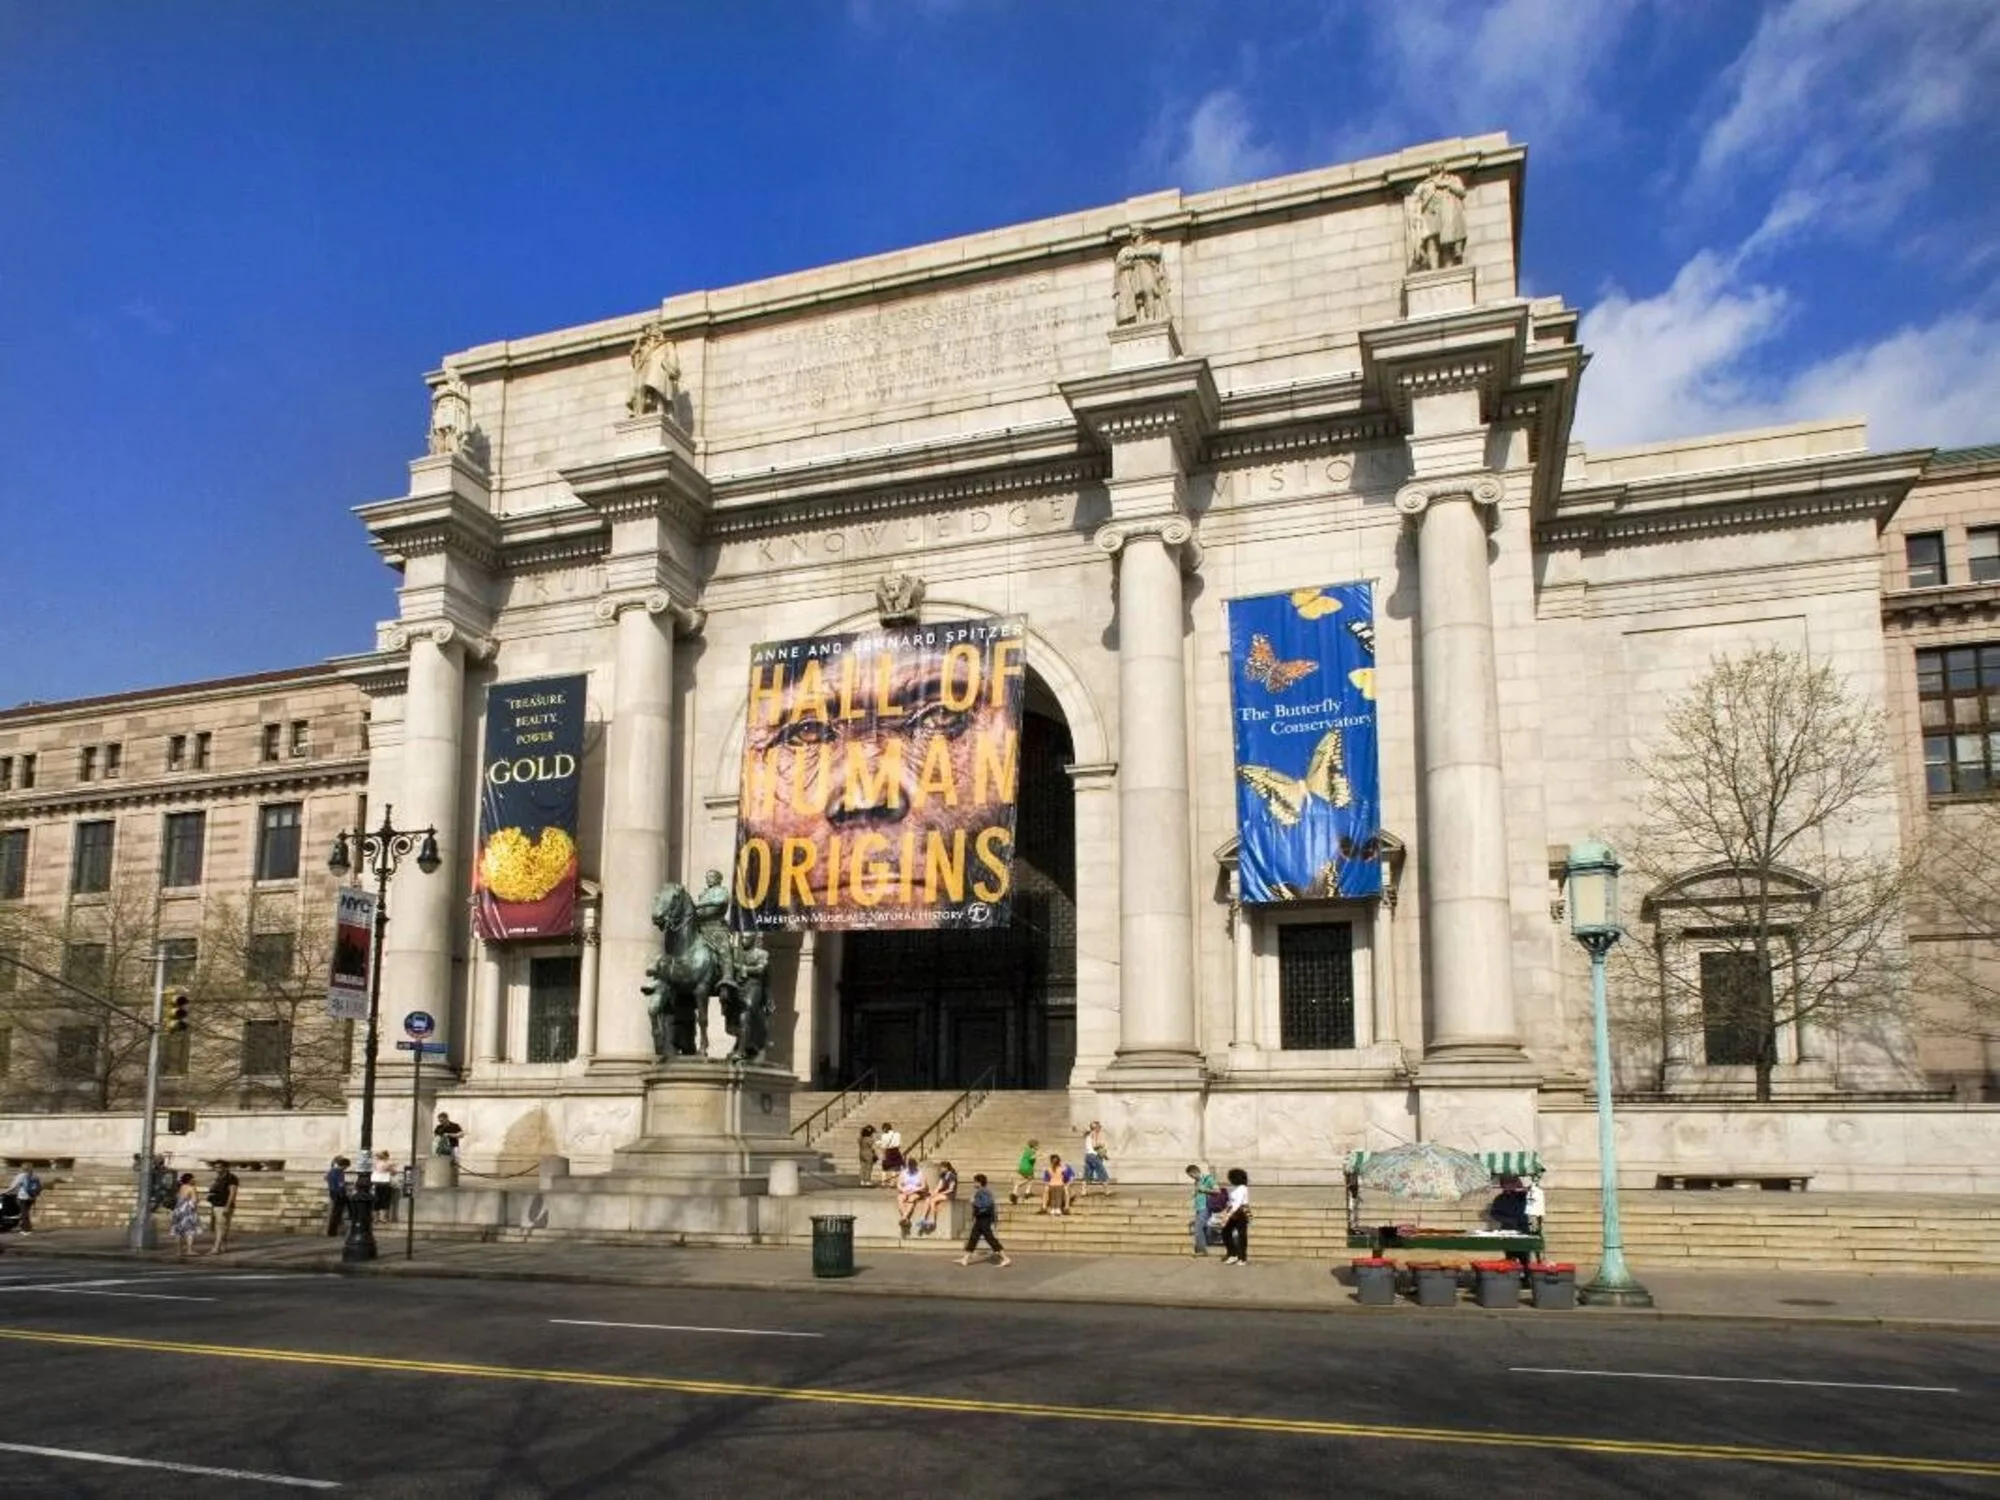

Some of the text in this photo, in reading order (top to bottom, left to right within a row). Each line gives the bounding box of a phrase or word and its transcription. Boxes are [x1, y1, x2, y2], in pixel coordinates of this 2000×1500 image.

[758, 500, 1066, 562] KNOWLEDGE
[755, 647, 799, 662] ANNE
[808, 643, 842, 656] AND
[946, 625, 1023, 643] SPITZER
[751, 640, 1023, 726] HALL OF
[1239, 698, 1343, 721] The Butterfly
[1270, 714, 1373, 735] Conservatory
[489, 754, 576, 784] GOLD
[742, 729, 1019, 824] HUMAN
[736, 826, 1011, 909] ORIGINS
[341, 894, 372, 913] NYC
